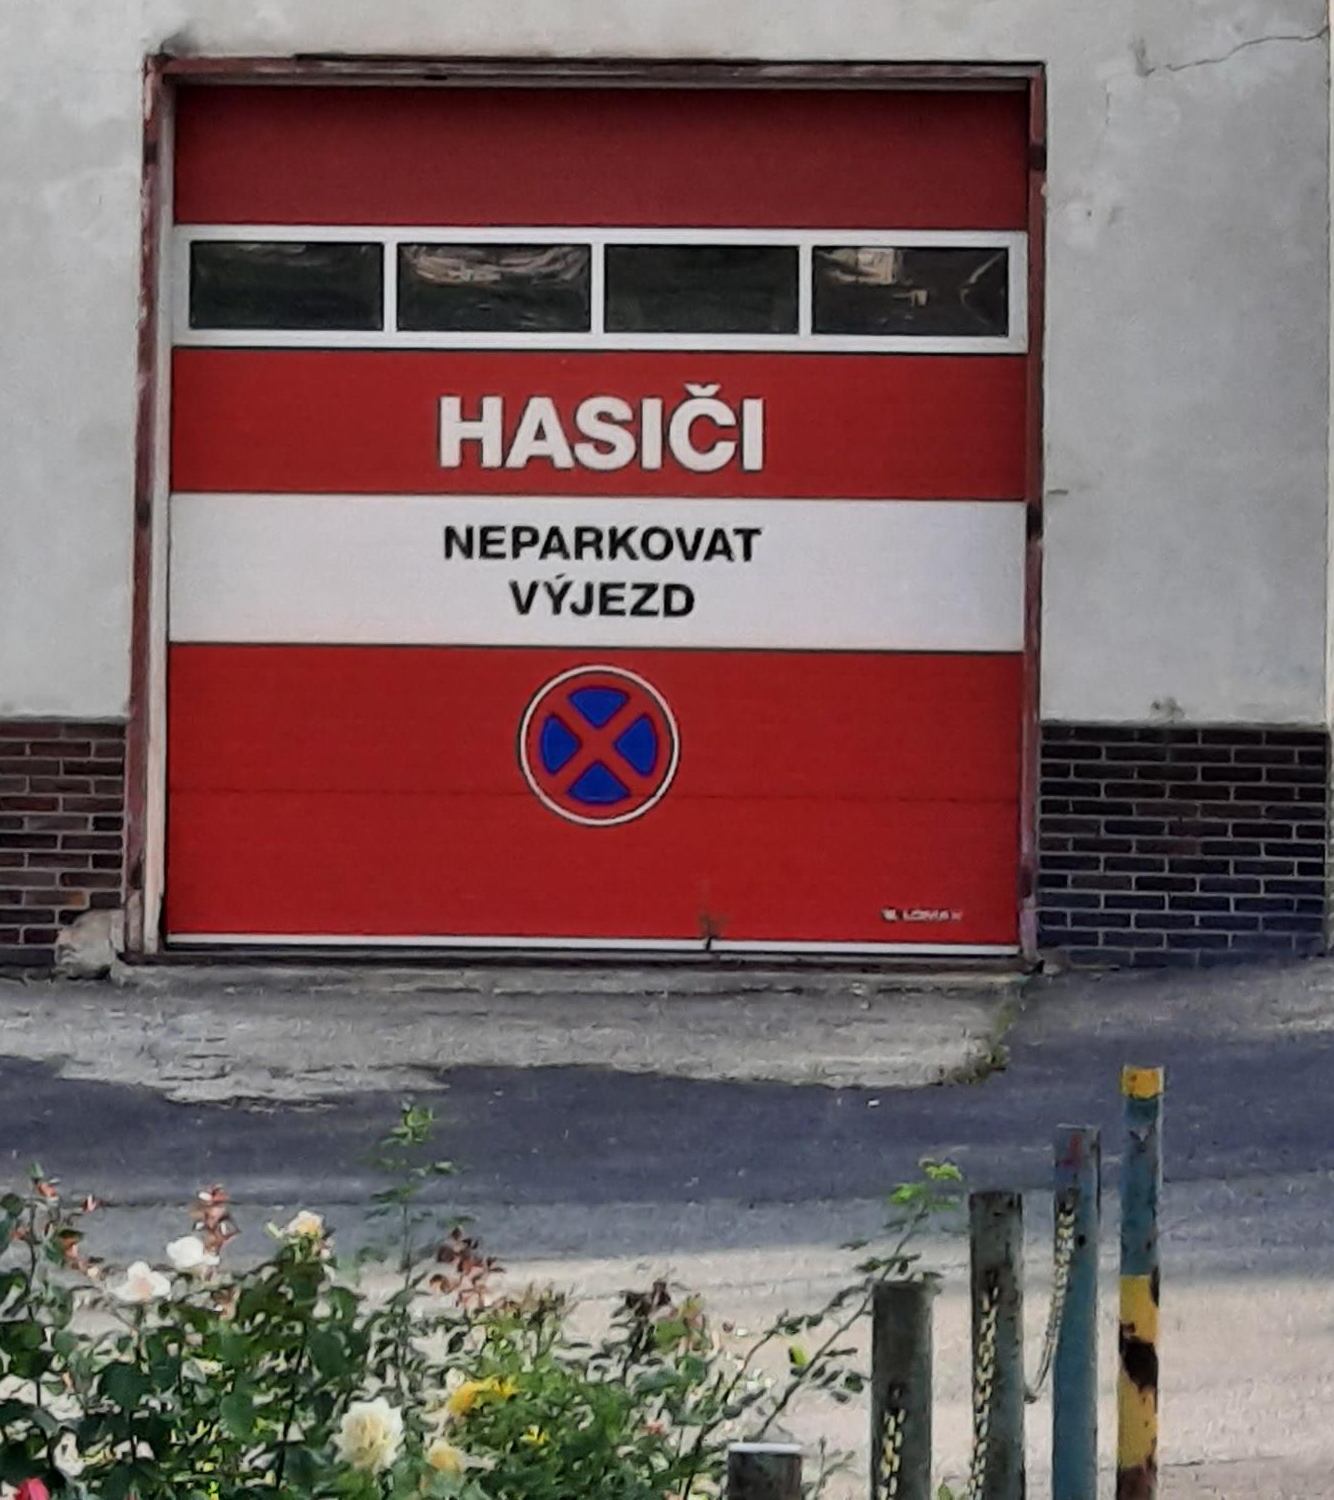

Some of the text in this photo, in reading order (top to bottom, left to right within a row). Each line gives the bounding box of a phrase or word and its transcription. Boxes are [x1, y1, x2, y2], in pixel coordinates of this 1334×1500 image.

[439, 382, 764, 472] HASIČI
[444, 525, 762, 562] NEPARKOVAT
[509, 573, 695, 617] VÝJEZD
